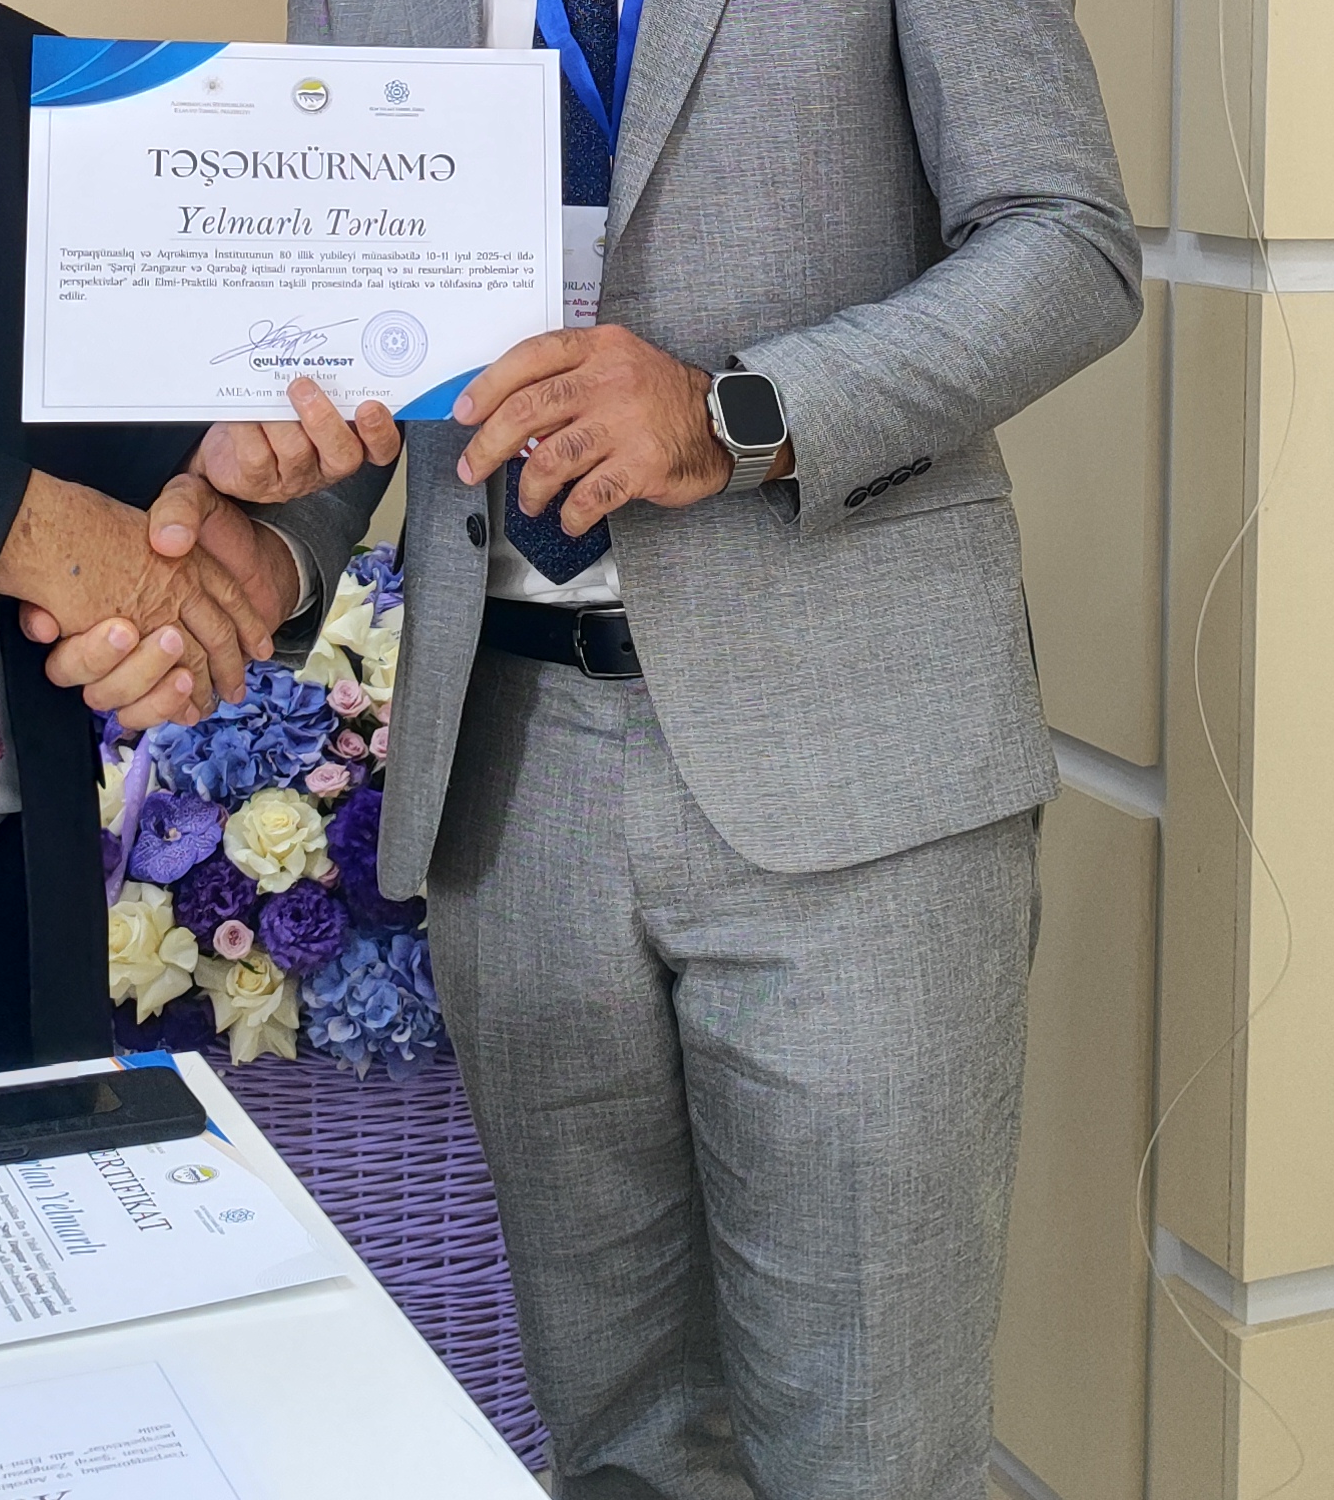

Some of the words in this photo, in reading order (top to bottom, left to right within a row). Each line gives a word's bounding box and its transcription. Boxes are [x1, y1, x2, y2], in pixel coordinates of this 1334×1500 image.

[148, 146, 456, 187] TƏŞƏKKÜRNAMƏ
[177, 206, 313, 236] Yelmarlı
[326, 208, 427, 237] Tərlan
[60, 247, 135, 260] Torpaqşünaslıq
[140, 250, 152, 258] və
[215, 247, 274, 259] İnstitutunun
[279, 250, 292, 260] 80
[297, 250, 314, 260] illik
[320, 250, 356, 262] yubileyi
[426, 251, 449, 261] 10-11
[455, 251, 471, 263] iyul
[477, 251, 512, 261] 2025-ci
[517, 251, 534, 261] ildə
[60, 261, 102, 273] keçirilən
[140, 263, 187, 274] Zəngəzur
[207, 263, 247, 275] Qarabağ
[251, 264, 286, 276] iqtisadi
[352, 266, 383, 276] torpaq
[468, 265, 519, 277] problemlər
[132, 277, 150, 287] adlı
[311, 279, 363, 290] prosesində
[424, 281, 435, 289] və
[487, 280, 508, 291] görə
[513, 279, 535, 289] təltif
[563, 281, 596, 291] RLAN
[59, 291, 87, 301] edilir.
[253, 355, 300, 367] QULİYEV
[303, 355, 355, 367] ƏLÖVSƏT
[274, 371, 291, 382] Baş
[344, 387, 394, 399] professor.
[15, 1160, 56, 1189] rlan
[87, 1148, 173, 1232] ERTİFİKAT
